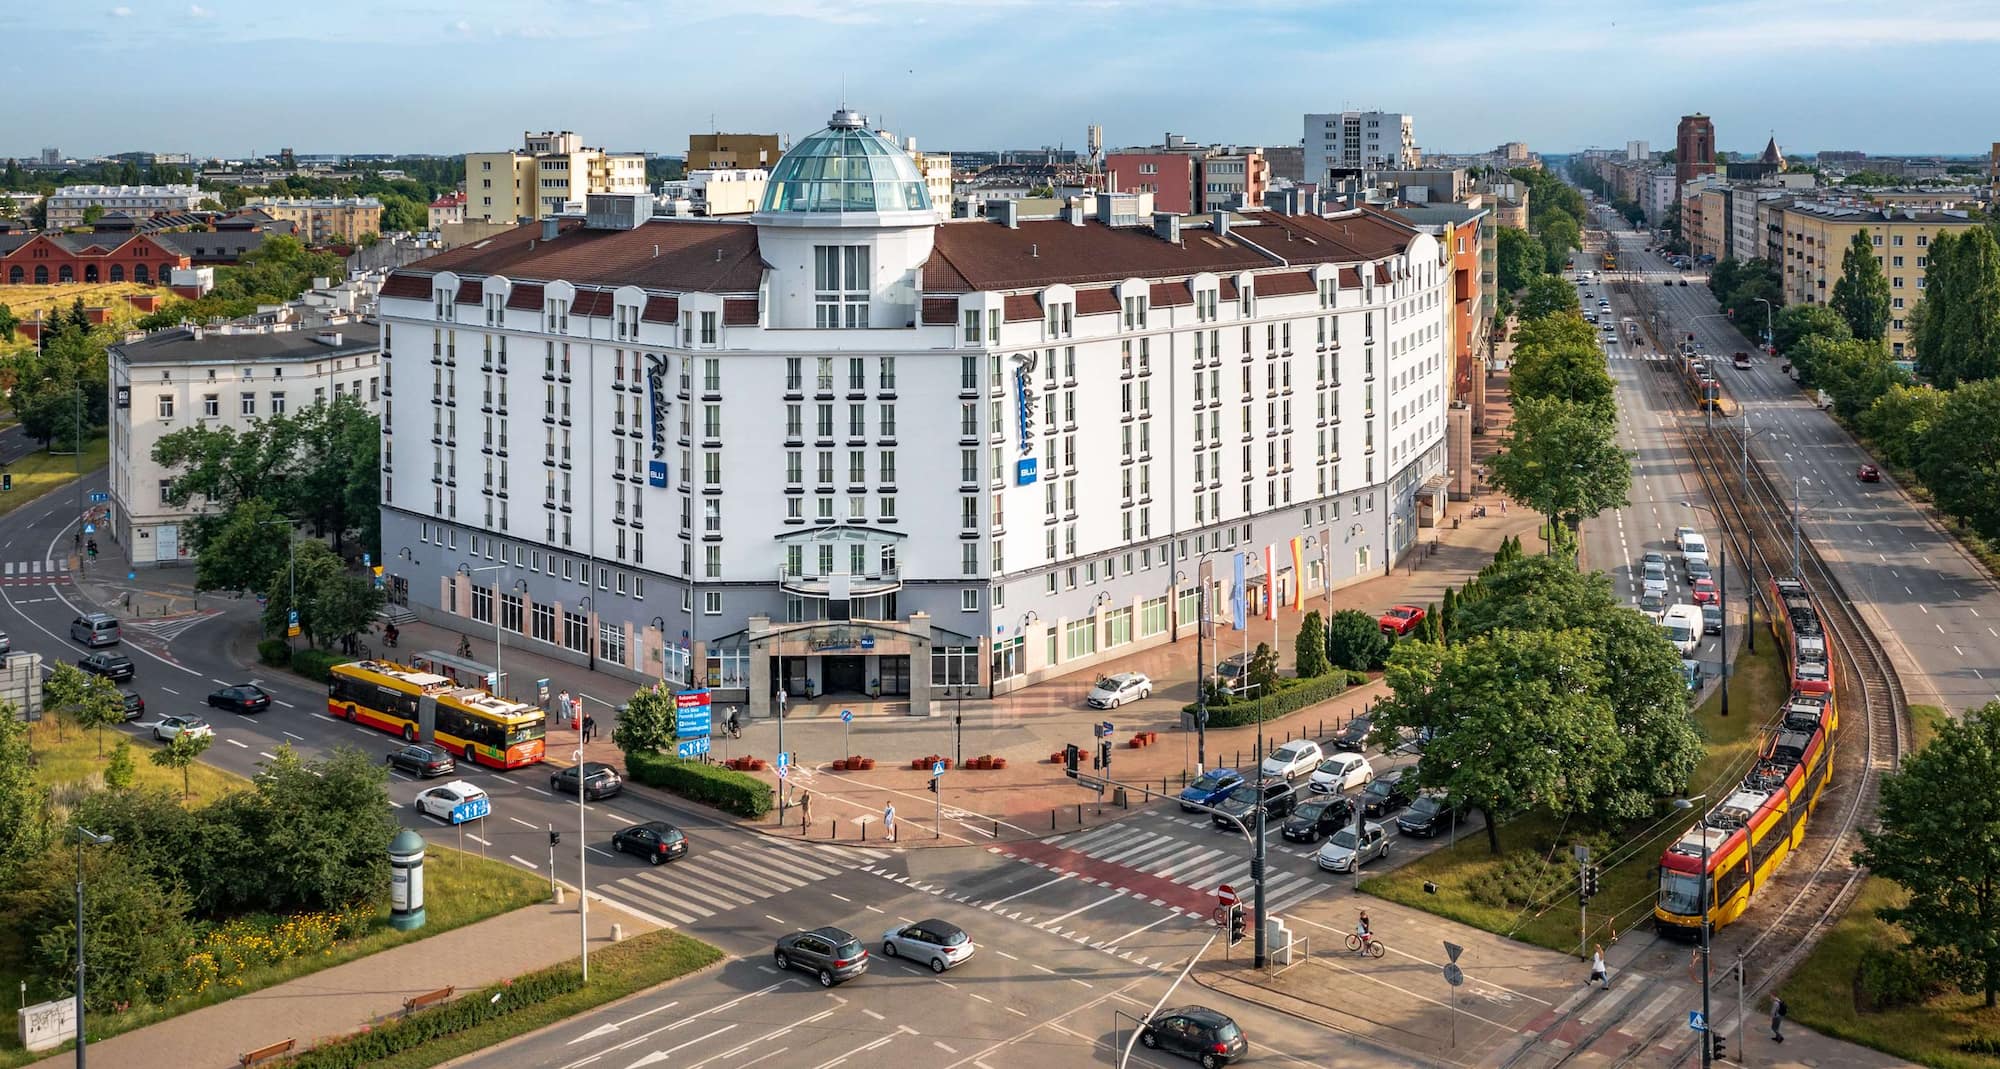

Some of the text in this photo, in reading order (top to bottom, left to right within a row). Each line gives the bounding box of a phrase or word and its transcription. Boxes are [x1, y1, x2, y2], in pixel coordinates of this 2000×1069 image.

[645, 353, 671, 459] Radisson
[1010, 351, 1041, 456] Radisson
[650, 470, 664, 480] BLU
[1020, 468, 1036, 477] BLU
